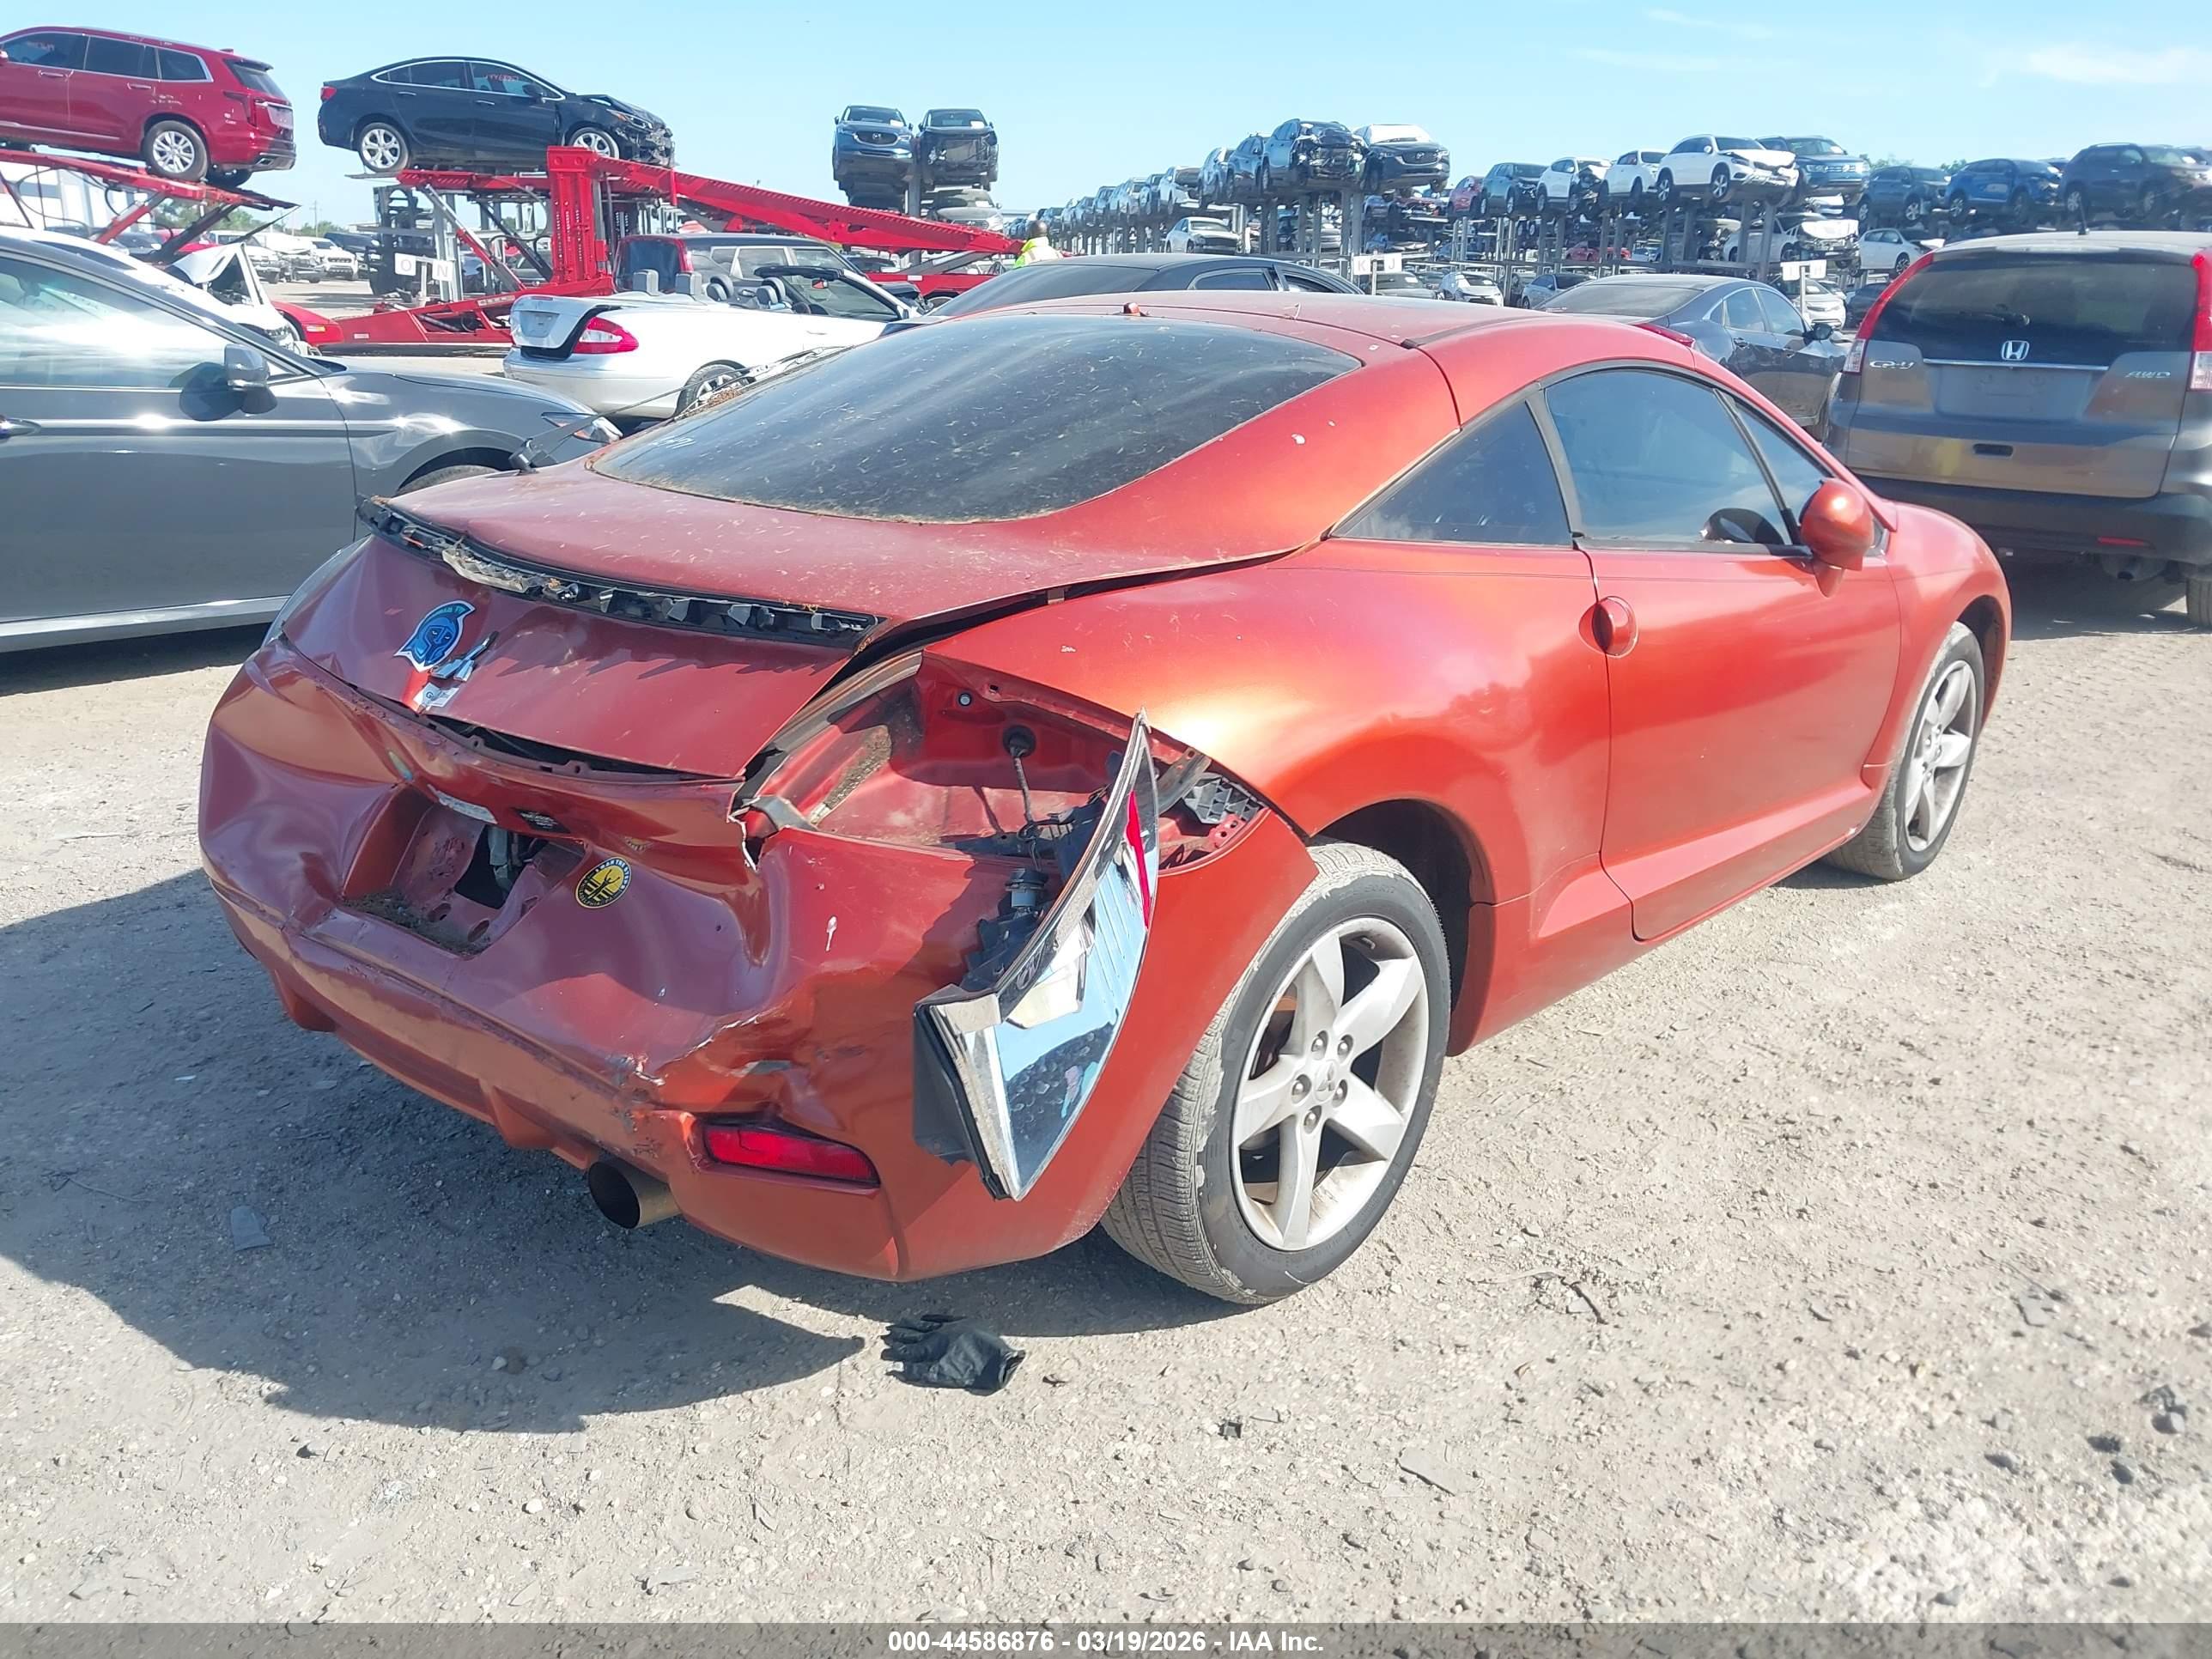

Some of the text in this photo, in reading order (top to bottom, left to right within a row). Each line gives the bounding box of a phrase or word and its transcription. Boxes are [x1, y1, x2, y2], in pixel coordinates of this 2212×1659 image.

[400, 258, 412, 272] O
[1358, 259, 1366, 271] K
[1388, 258, 1395, 270] J
[436, 264, 449, 278] N
